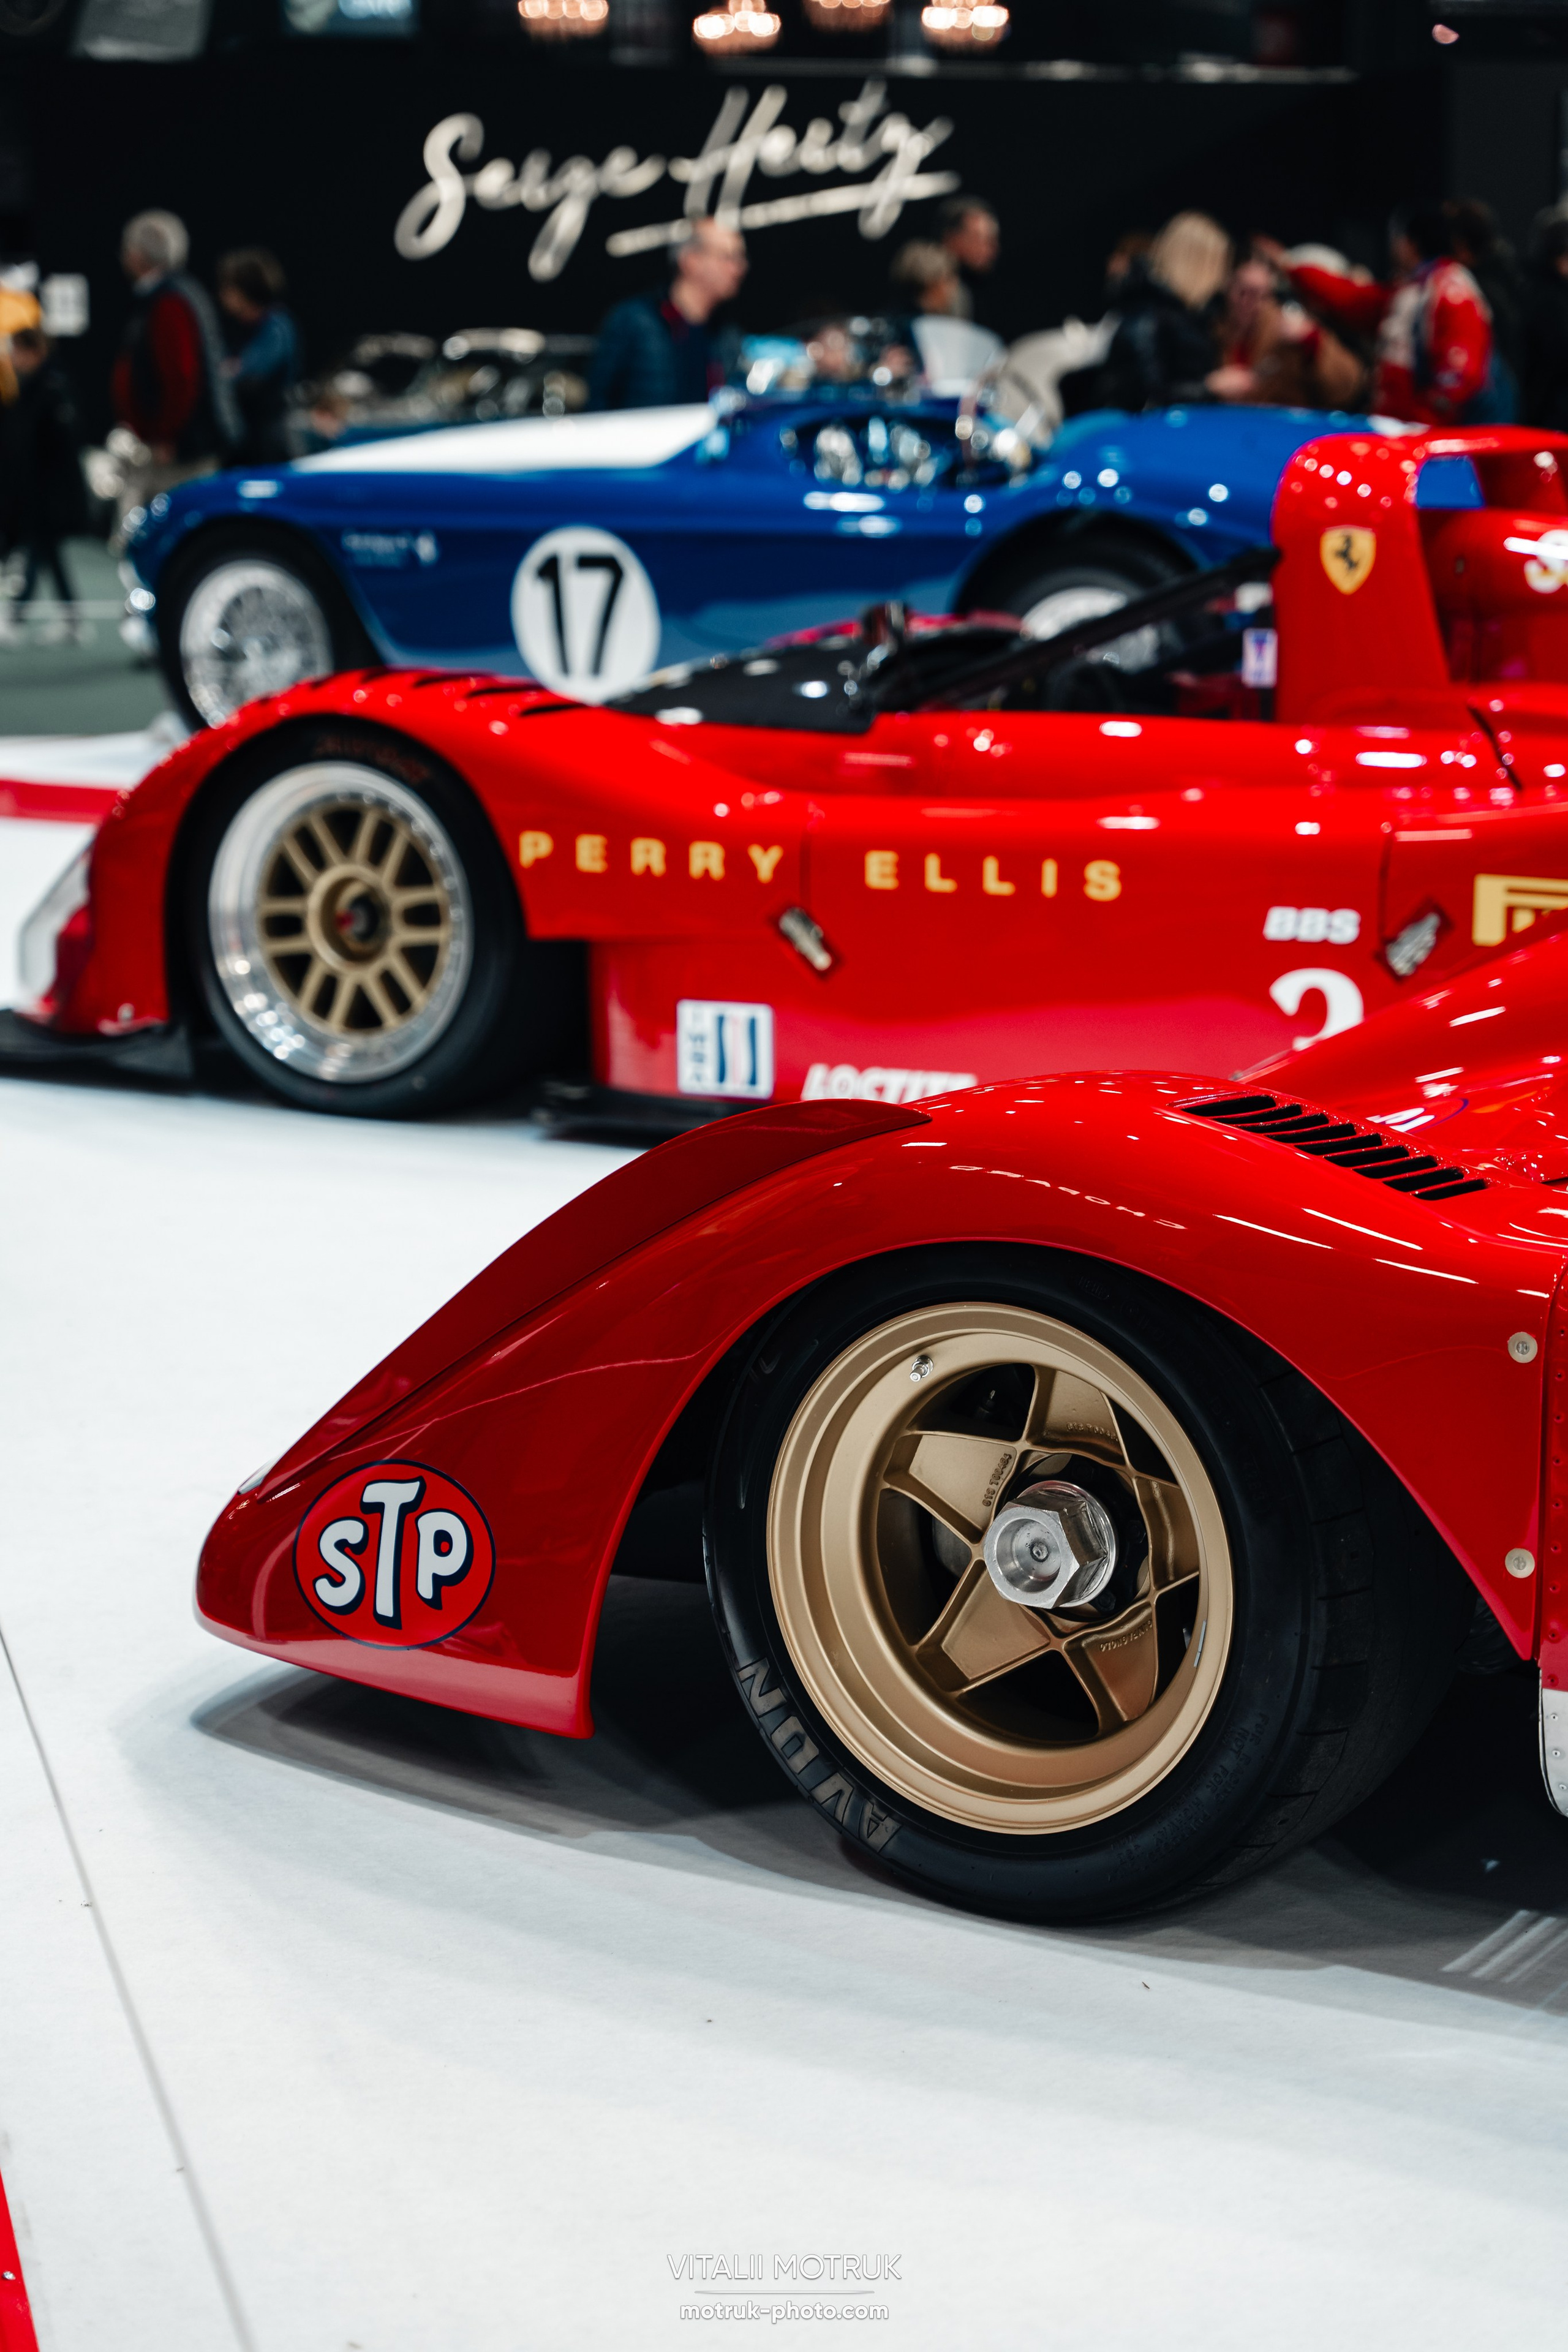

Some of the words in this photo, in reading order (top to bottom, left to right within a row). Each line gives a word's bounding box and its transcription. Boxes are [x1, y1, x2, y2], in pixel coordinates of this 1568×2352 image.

[394, 112, 666, 282] Serge
[537, 553, 624, 677] 17
[519, 831, 783, 883] PERRY
[864, 850, 1122, 902] ELLIS
[313, 1476, 473, 1630] STP
[736, 1656, 903, 1853] AVON
